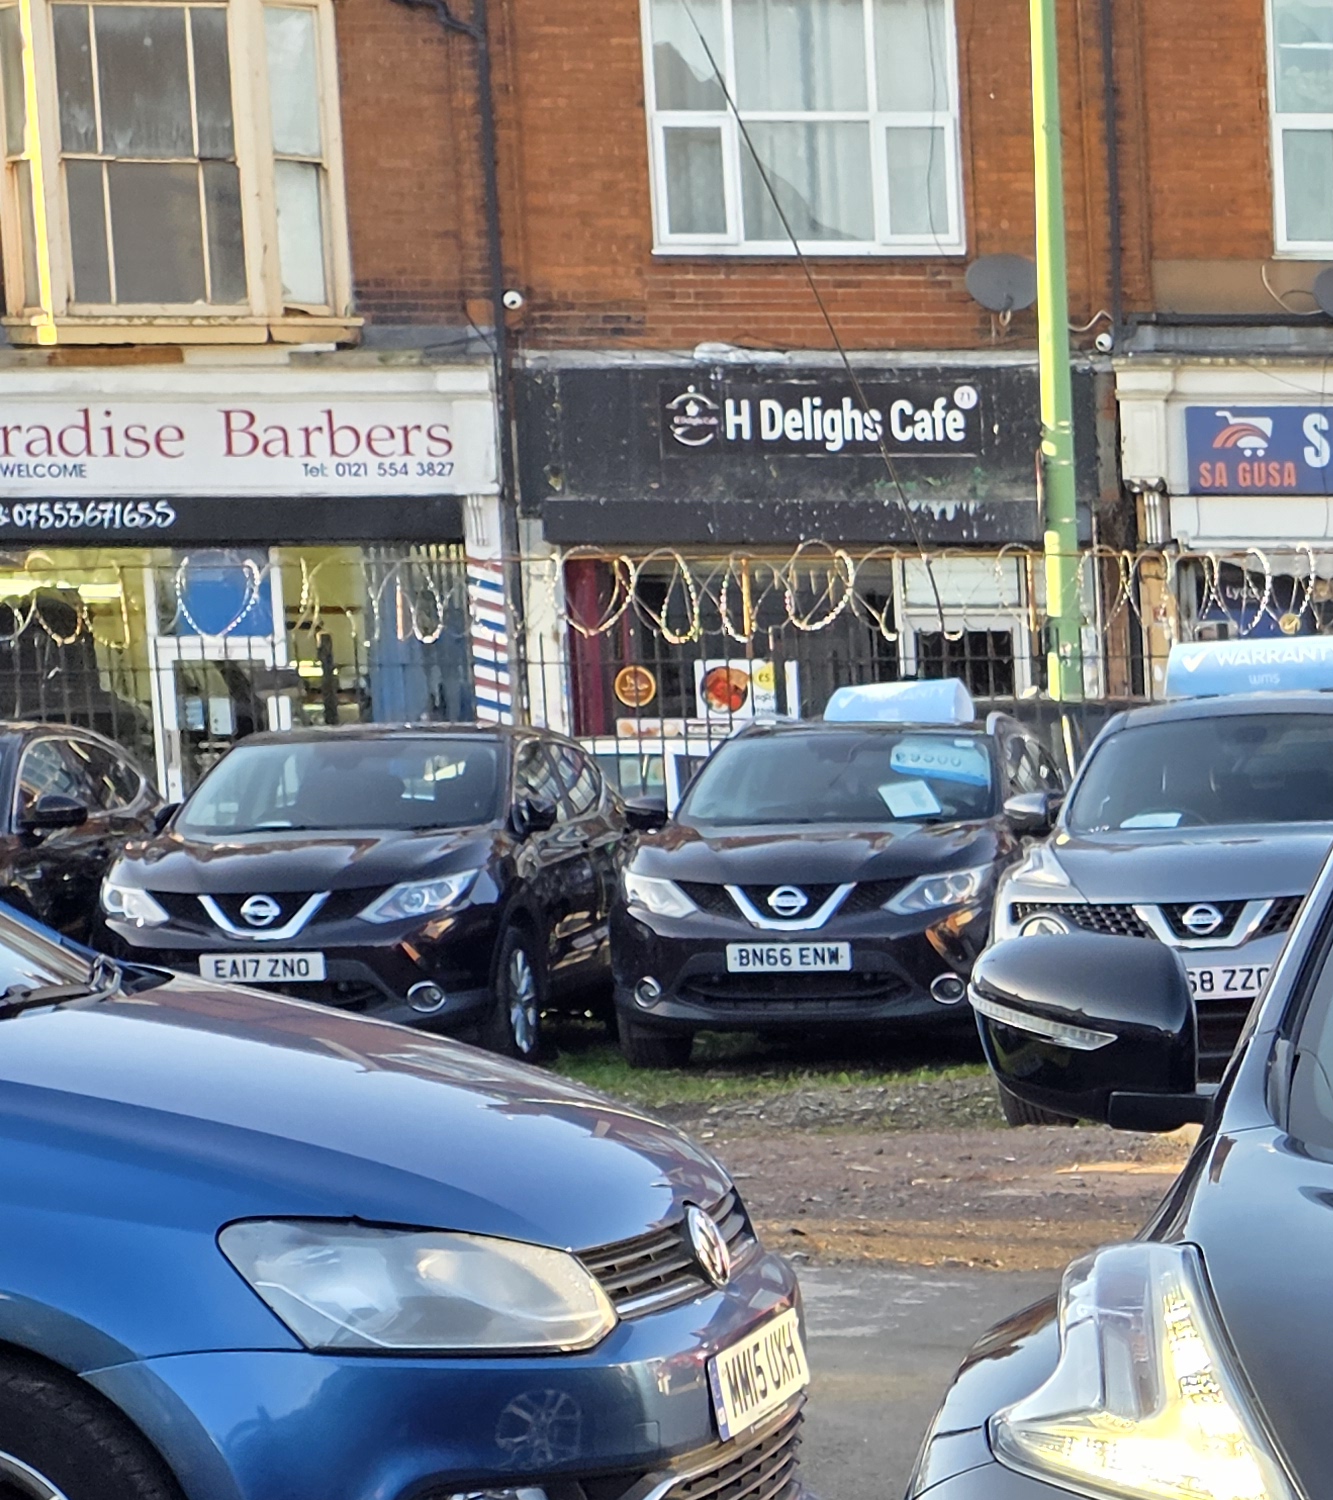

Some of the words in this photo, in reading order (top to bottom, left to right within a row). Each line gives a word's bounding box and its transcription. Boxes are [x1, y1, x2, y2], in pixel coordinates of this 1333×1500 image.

[218, 408, 454, 459] Barbers
[725, 398, 751, 441] H
[759, 396, 883, 452] Delighs
[890, 397, 966, 442] Cafe
[0, 463, 87, 479] WELCOME
[335, 462, 368, 477] 0121
[377, 462, 408, 477] 554
[416, 462, 455, 477] 3827
[1199, 462, 1228, 488] SA
[1238, 461, 1297, 487] GUSA
[1248, 673, 1281, 685] wms
[738, 948, 793, 968] BN66
[798, 947, 841, 967] ENW
[213, 960, 259, 980] EA17
[268, 958, 310, 977] ZNO
[725, 1341, 768, 1418] MM15
[764, 1320, 802, 1390] UXH
